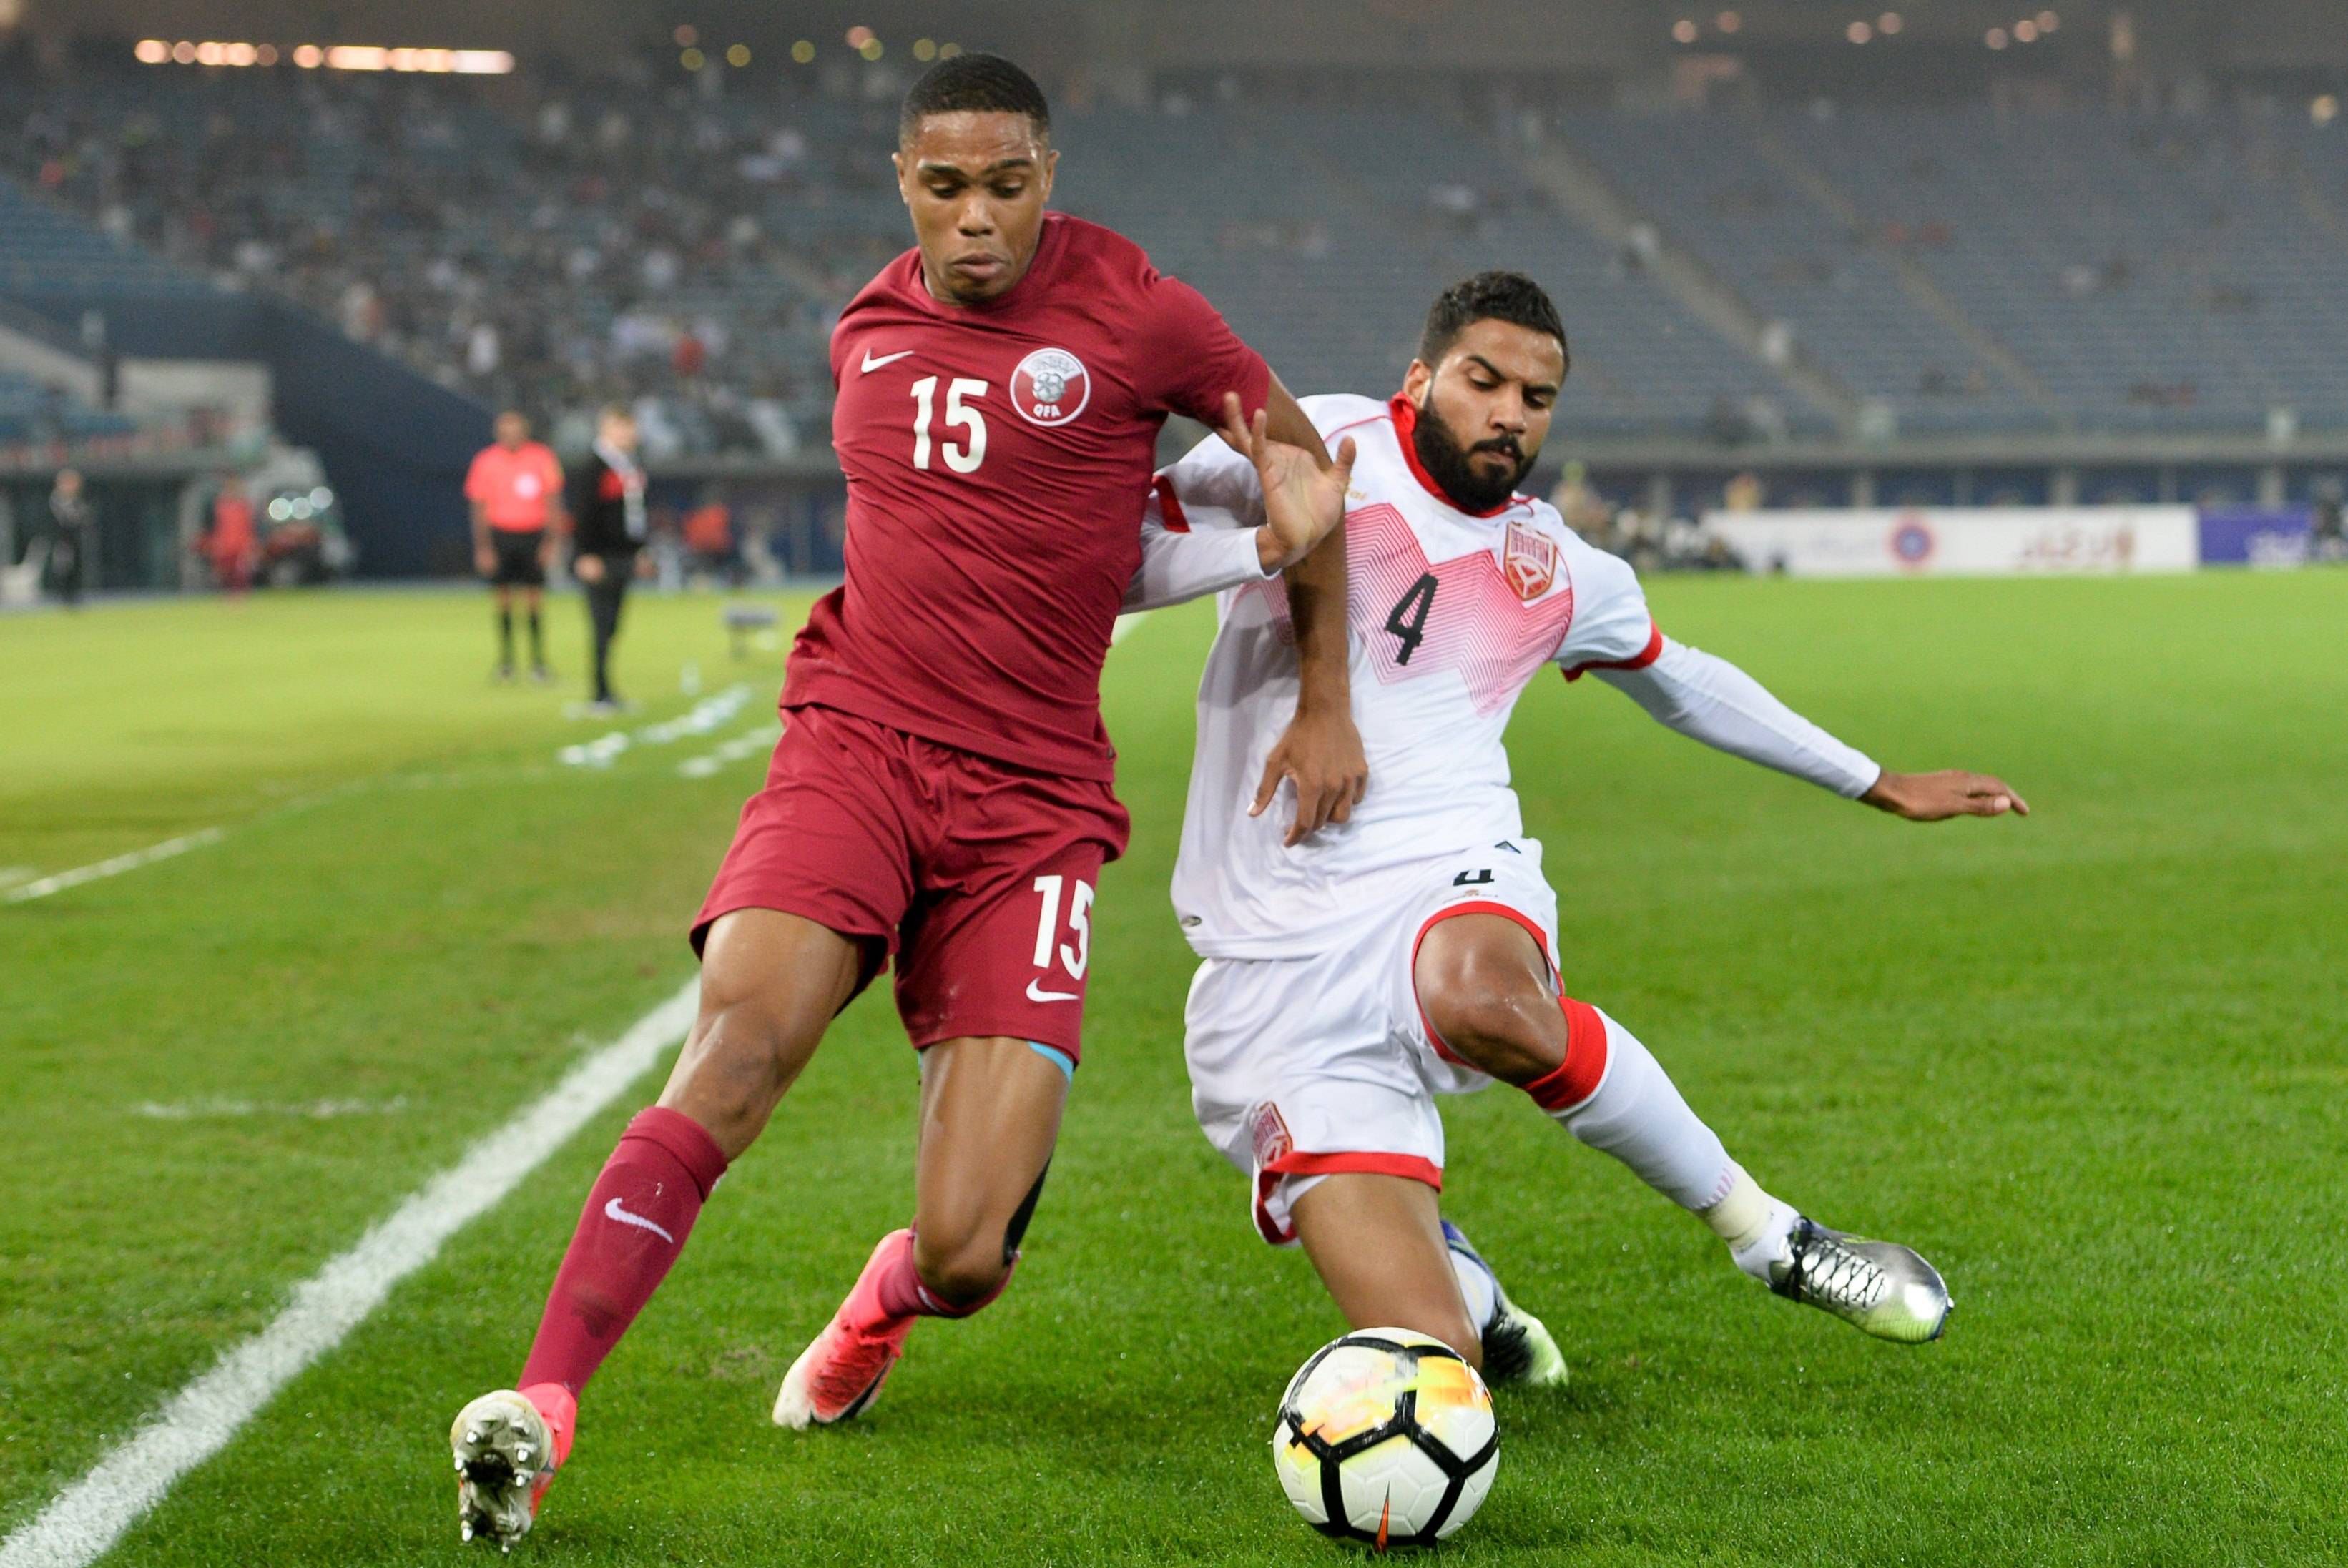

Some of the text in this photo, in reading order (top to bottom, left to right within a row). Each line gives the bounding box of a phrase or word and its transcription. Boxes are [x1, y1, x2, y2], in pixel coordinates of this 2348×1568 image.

[910, 375, 989, 473] 15
[1033, 403, 1061, 418] QFA
[1384, 571, 1439, 666] 4
[1033, 874, 1095, 981] 15
